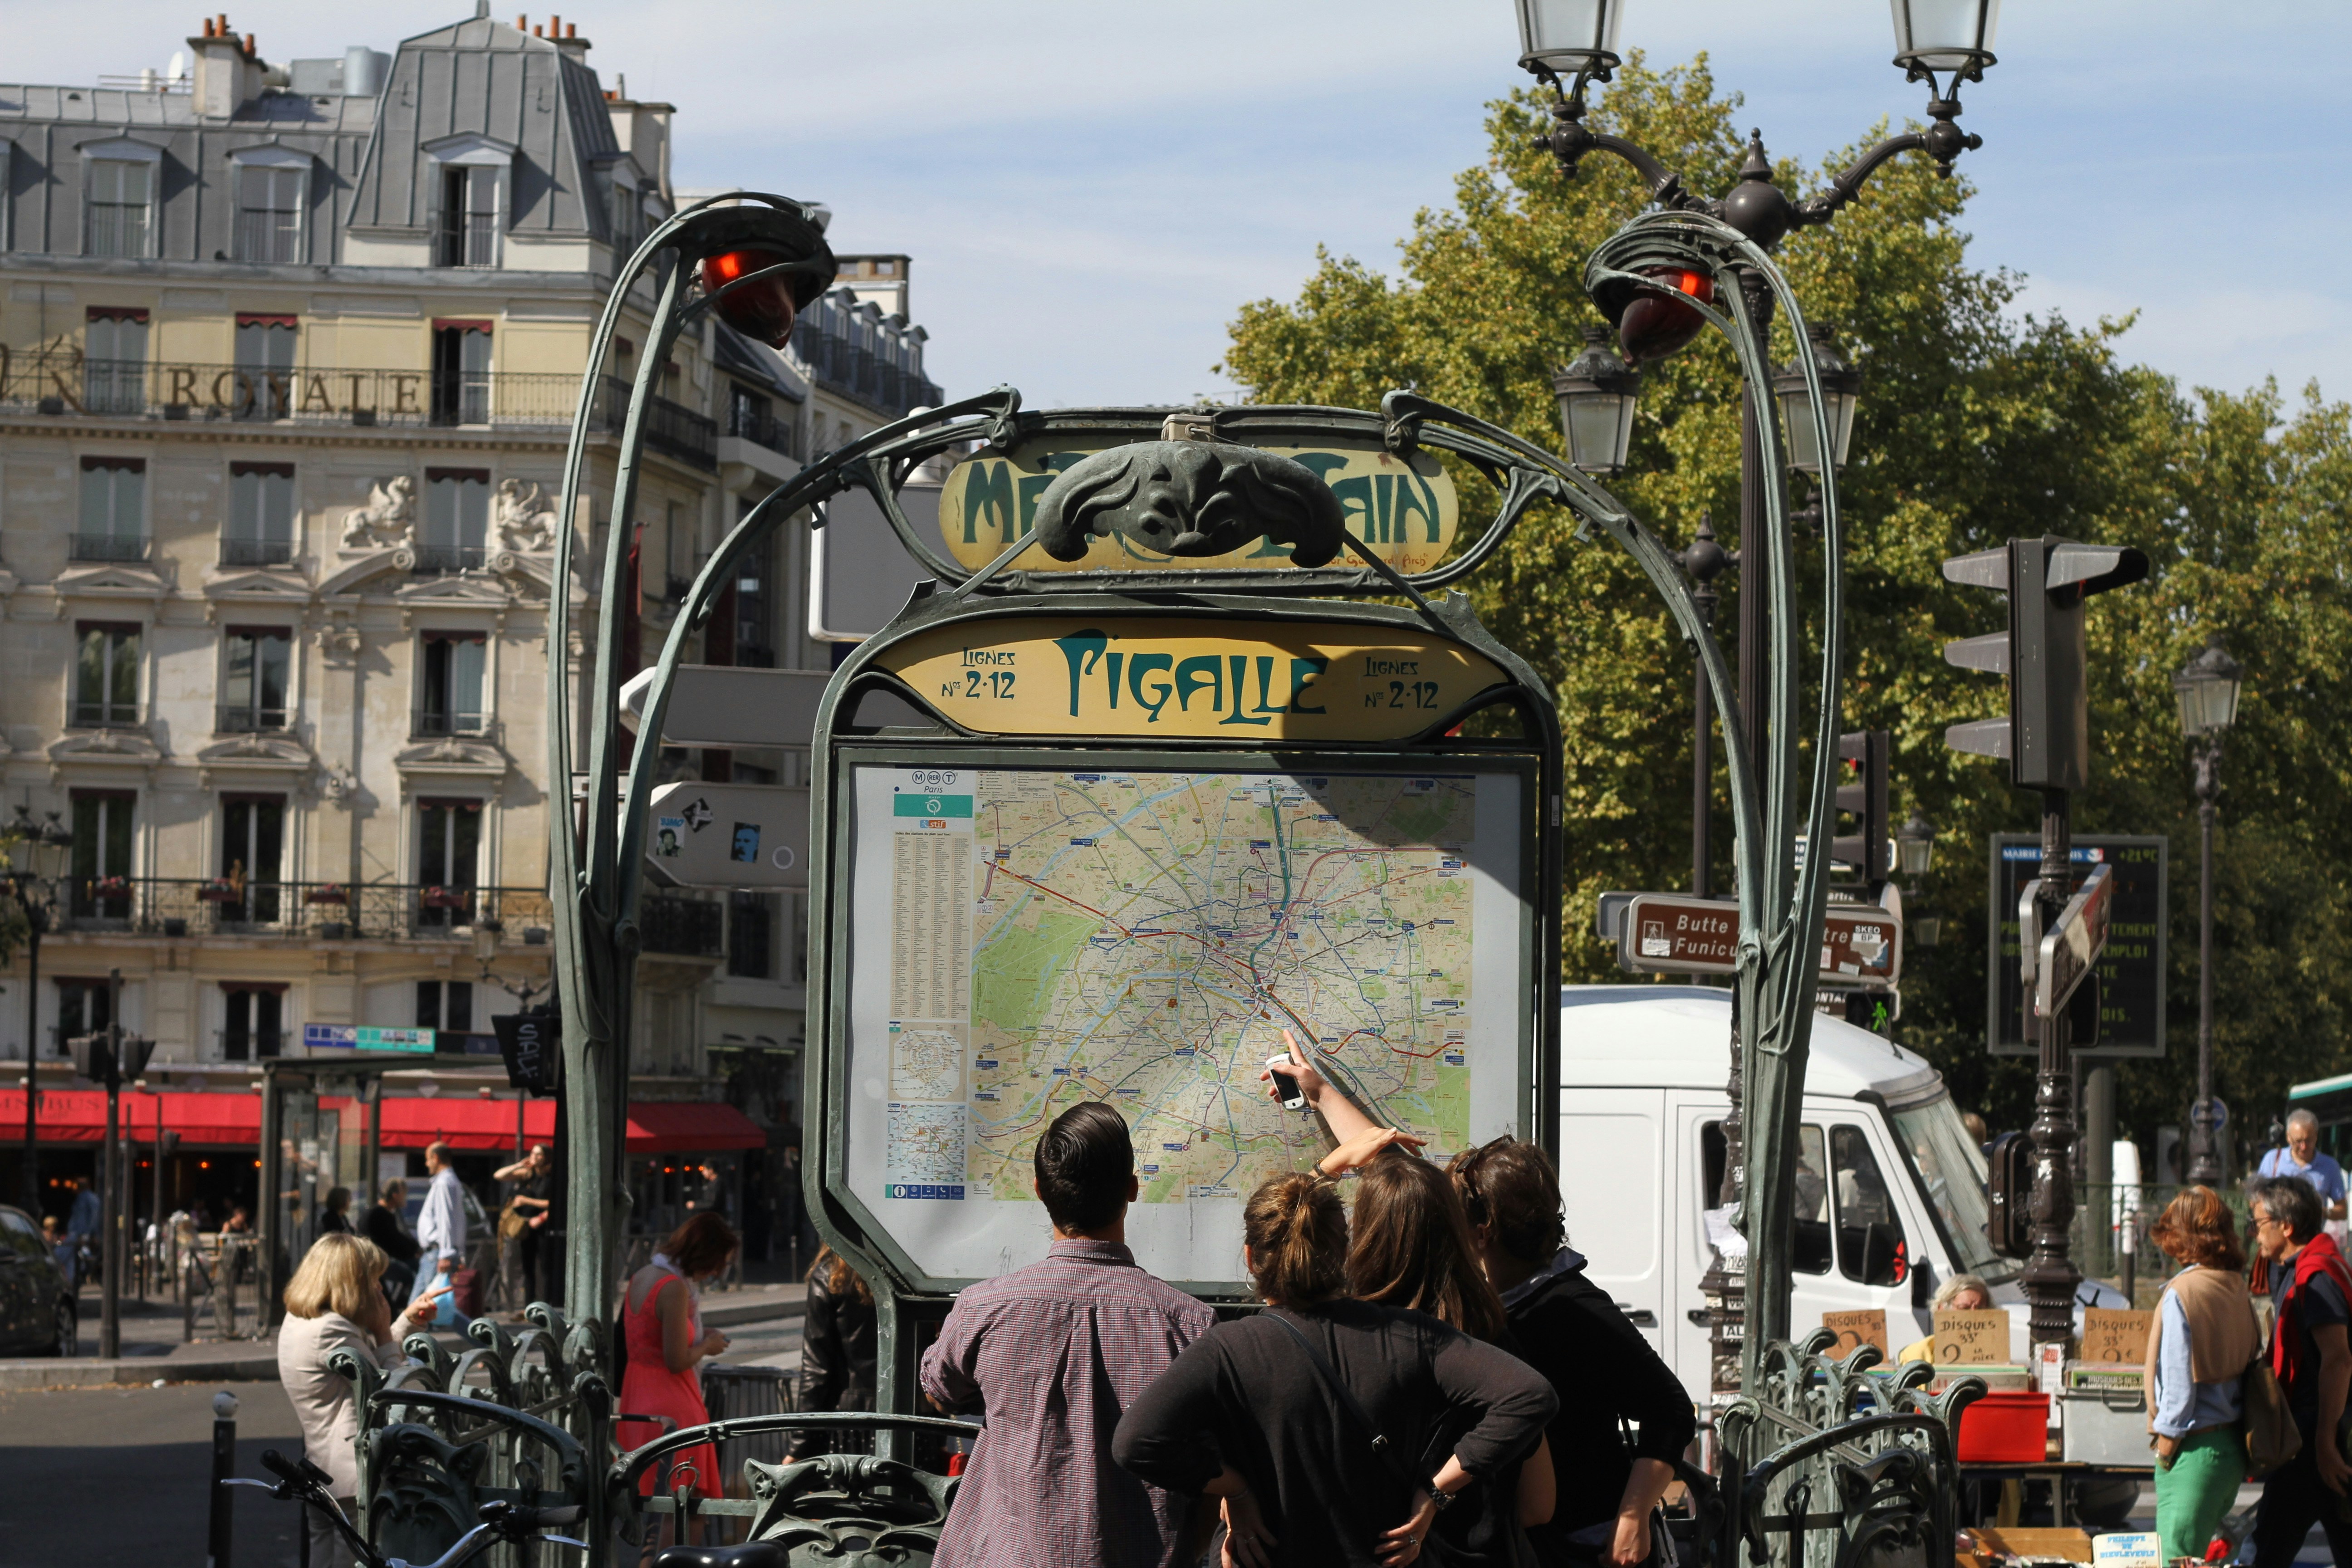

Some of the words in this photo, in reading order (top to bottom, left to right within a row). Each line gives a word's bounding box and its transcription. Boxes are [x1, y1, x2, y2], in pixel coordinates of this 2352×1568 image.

[960, 647, 1015, 667] LIGNES
[1363, 657, 1418, 676] LIGNES
[1052, 628, 1329, 726] PIGALLE
[2003, 848, 2037, 859] MAIRIE
[1676, 915, 1728, 934] Butte
[1940, 1316, 1996, 1332] DISQUES
[2088, 1318, 2144, 1333] DISQUES
